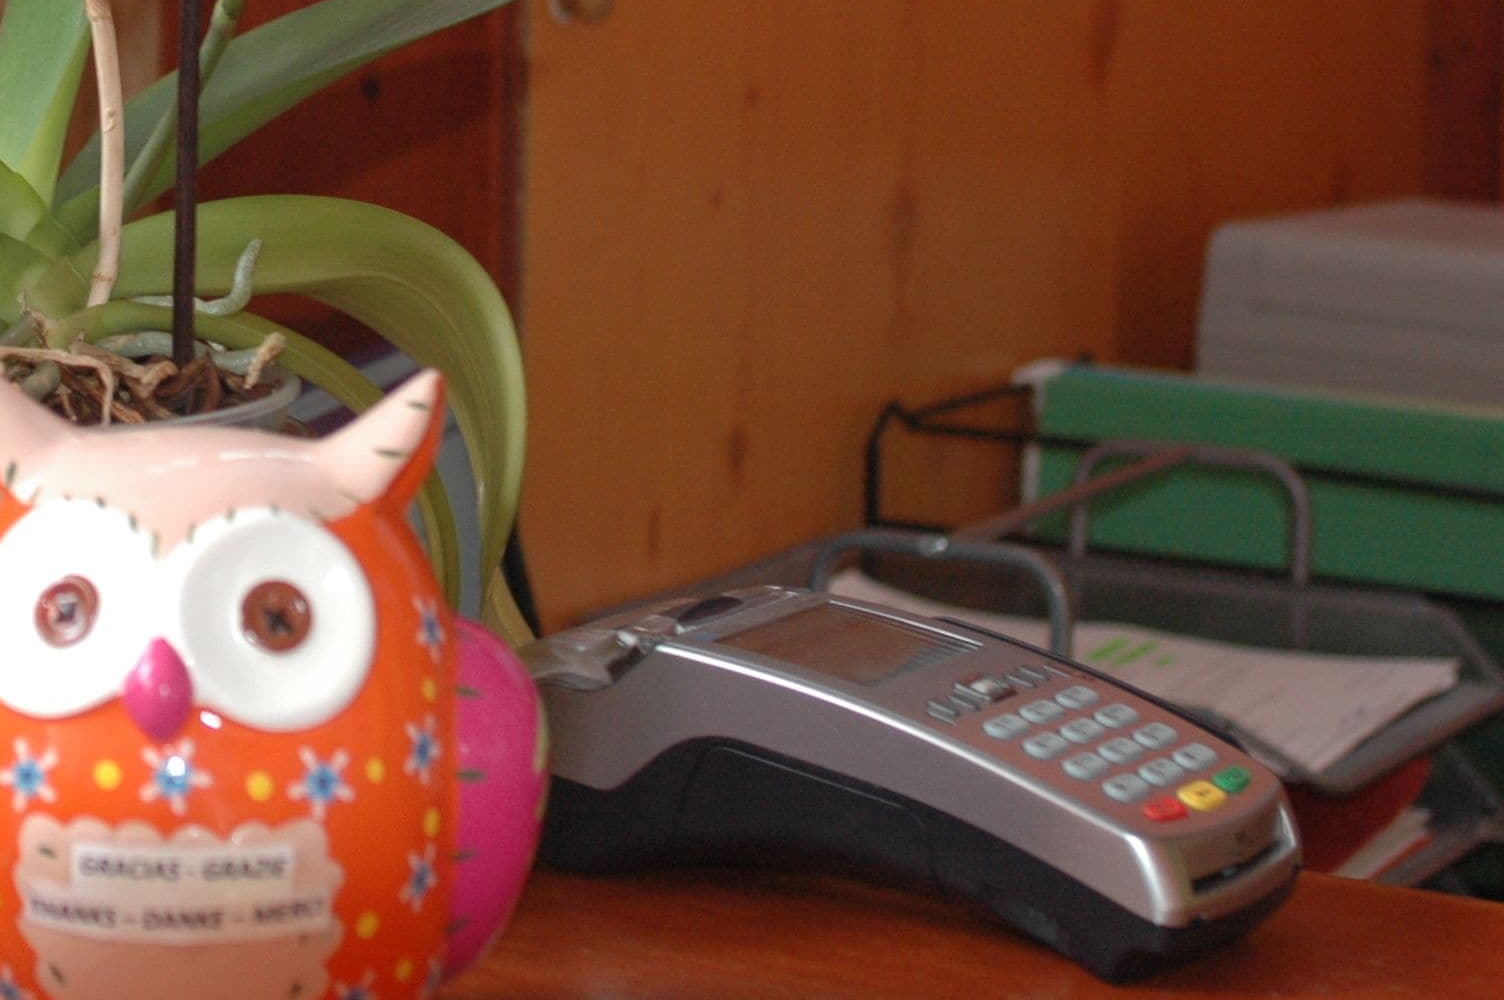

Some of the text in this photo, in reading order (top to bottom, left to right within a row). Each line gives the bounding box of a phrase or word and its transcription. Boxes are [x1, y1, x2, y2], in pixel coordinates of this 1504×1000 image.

[79, 857, 180, 881] GRACIAS
[202, 857, 287, 881] GRAZIE
[31, 898, 117, 927] THANKS
[142, 910, 225, 929] DANKE
[253, 899, 325, 925] MERCI
